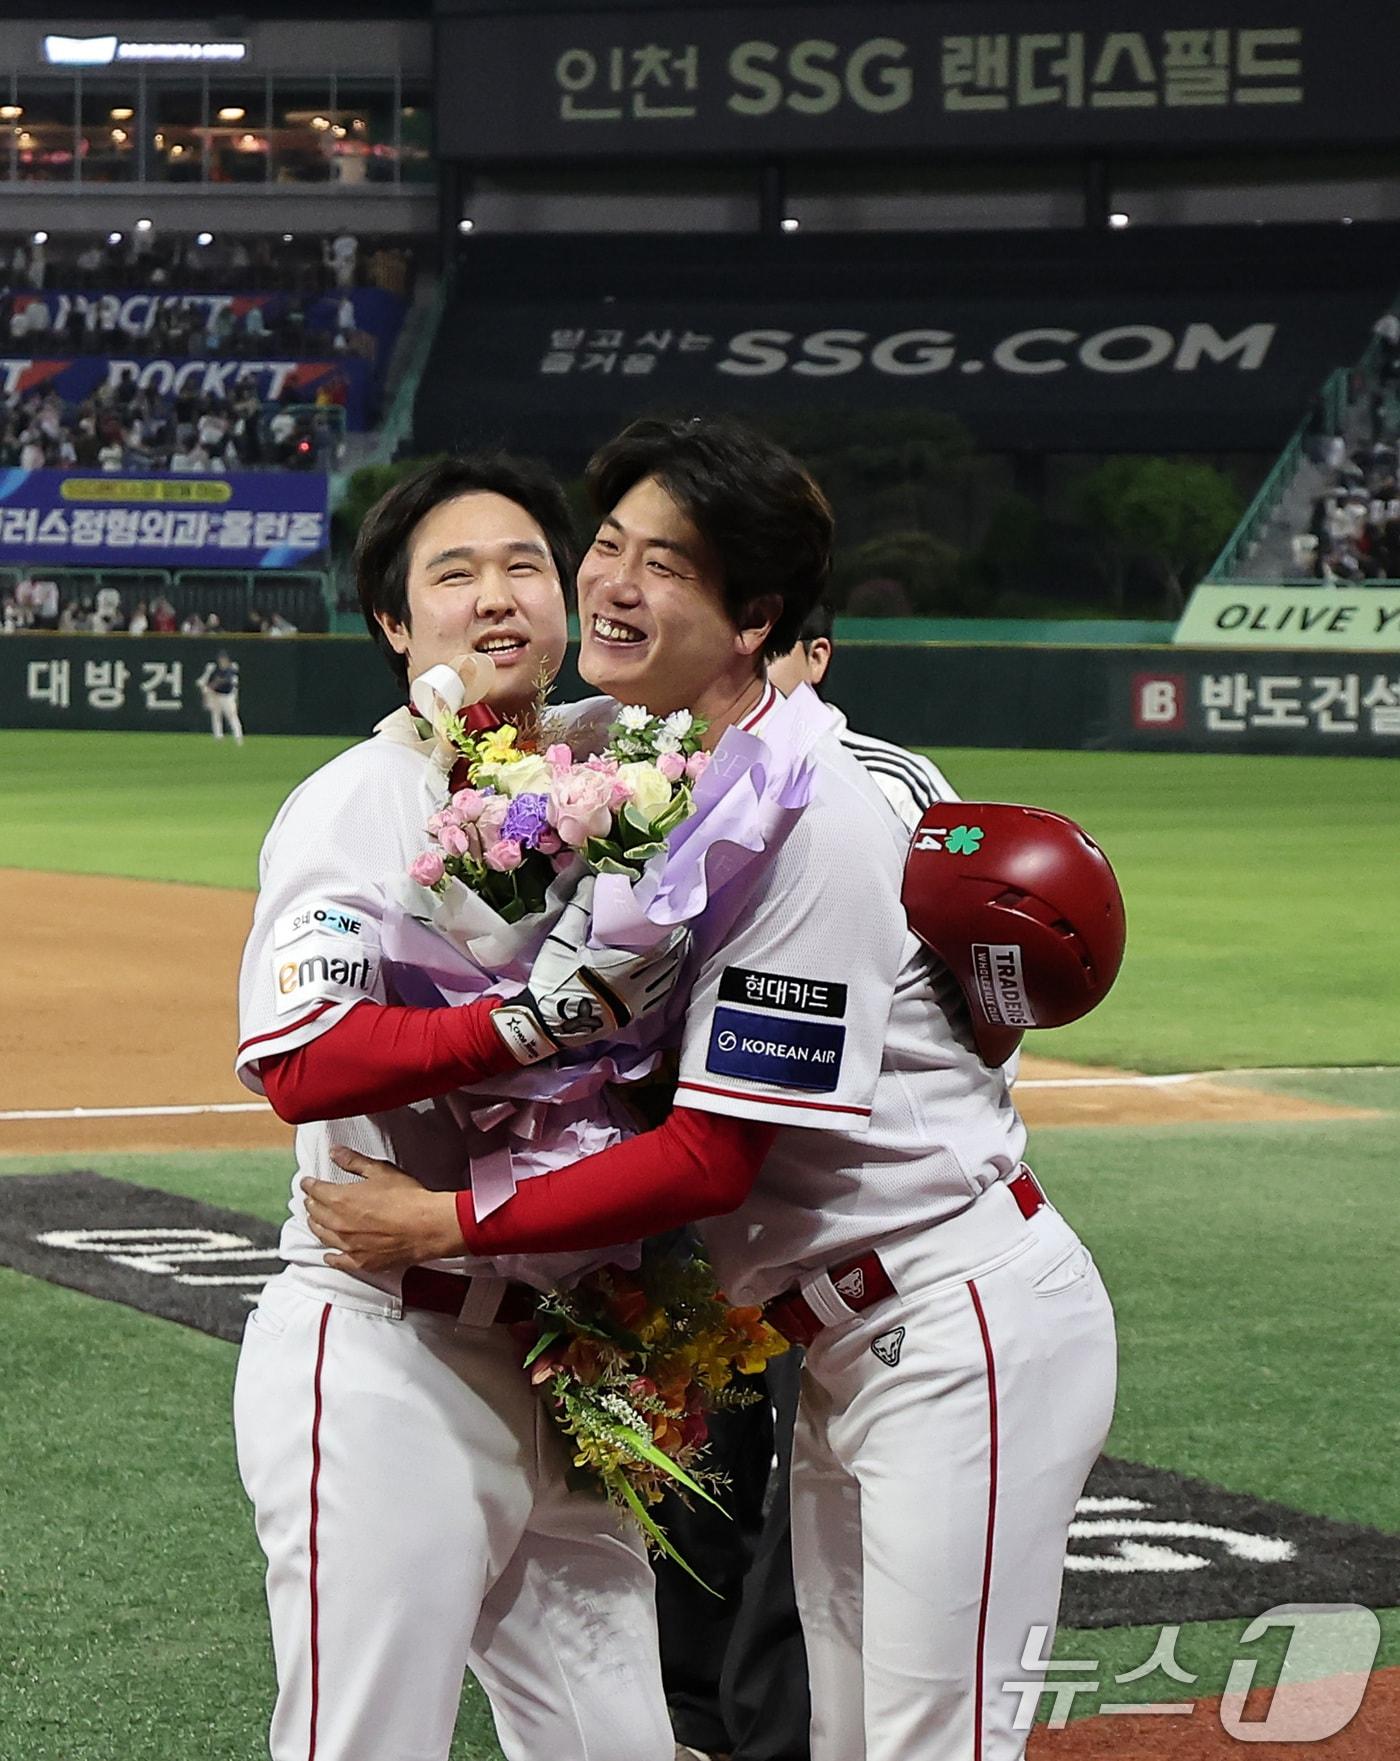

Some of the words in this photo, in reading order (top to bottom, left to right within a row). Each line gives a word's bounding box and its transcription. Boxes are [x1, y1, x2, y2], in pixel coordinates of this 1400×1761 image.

[556, 44, 699, 119] 인천
[728, 37, 913, 115] SSG
[942, 28, 1302, 110] 랜더스필드
[716, 323, 1277, 377] SSG.COM
[0, 508, 208, 548] 러스정형외과
[1216, 604, 1359, 632] OLIVE
[27, 659, 239, 711] 대방건
[914, 828, 947, 850] 14
[279, 955, 373, 994] emart
[745, 975, 828, 1008] 현대카드
[996, 951, 1028, 1025] TRADERS
[741, 1038, 808, 1061] KOREAN
[811, 1048, 836, 1064] AIR
